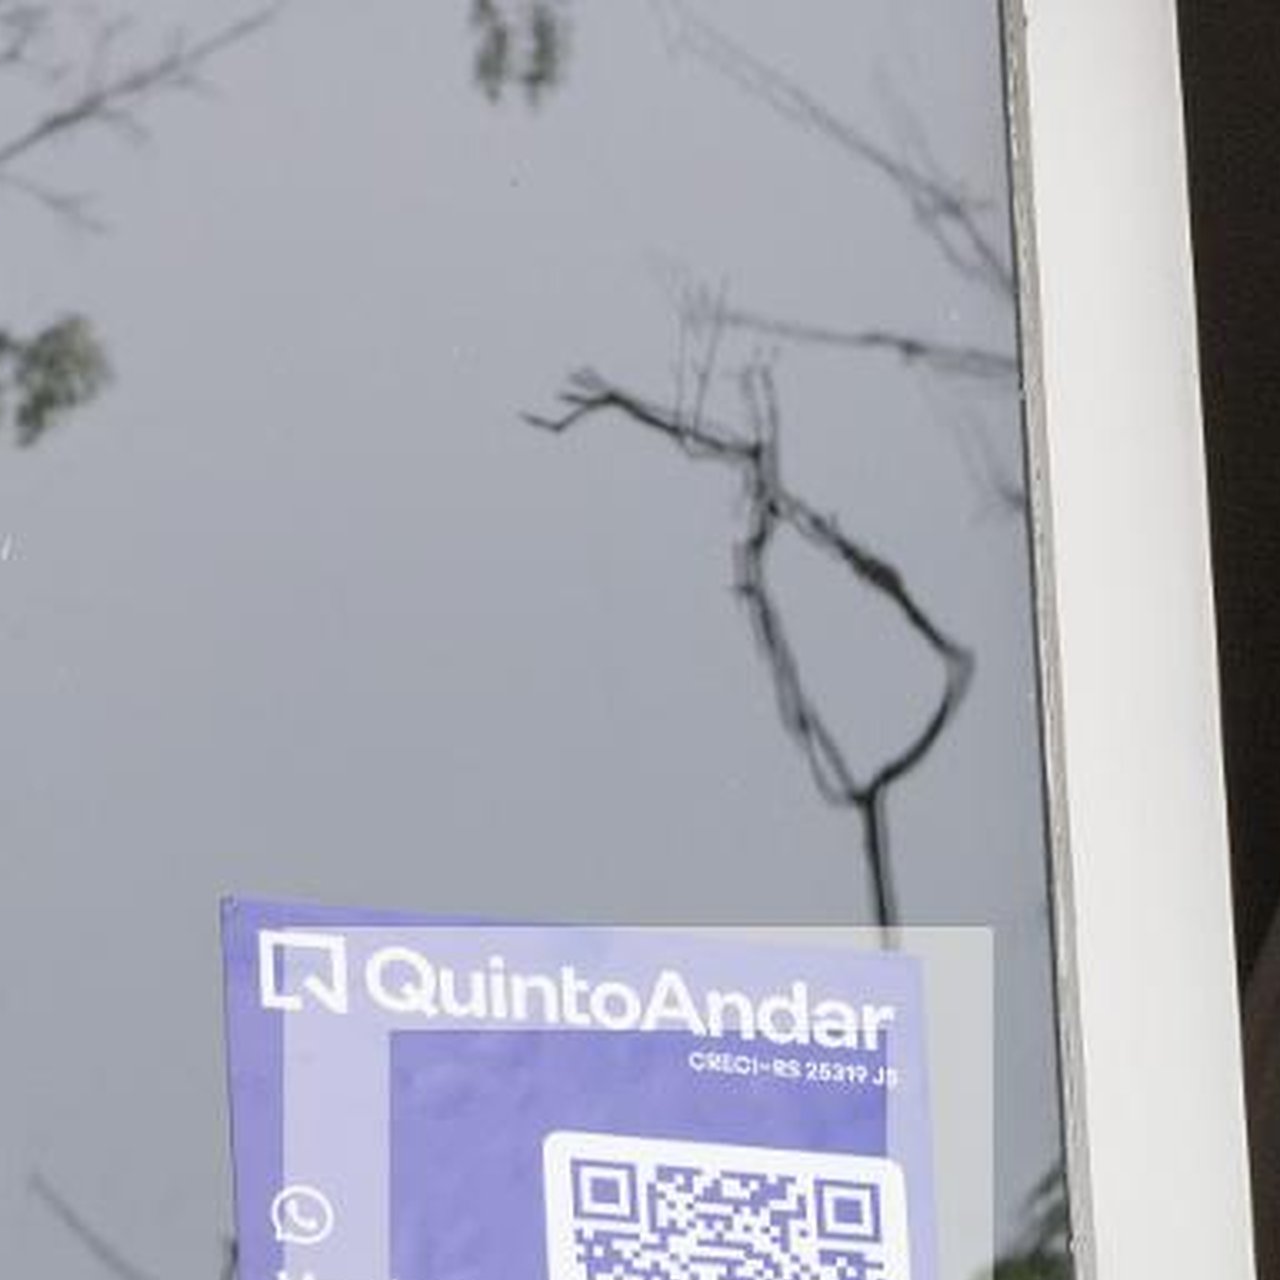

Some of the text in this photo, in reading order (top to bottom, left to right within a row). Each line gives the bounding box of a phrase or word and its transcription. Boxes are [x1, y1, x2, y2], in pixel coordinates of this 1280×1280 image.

[365, 946, 895, 1050] QuintoAndar
[688, 1051, 802, 1078] CRECI-RS
[805, 1061, 867, 1083] 25319
